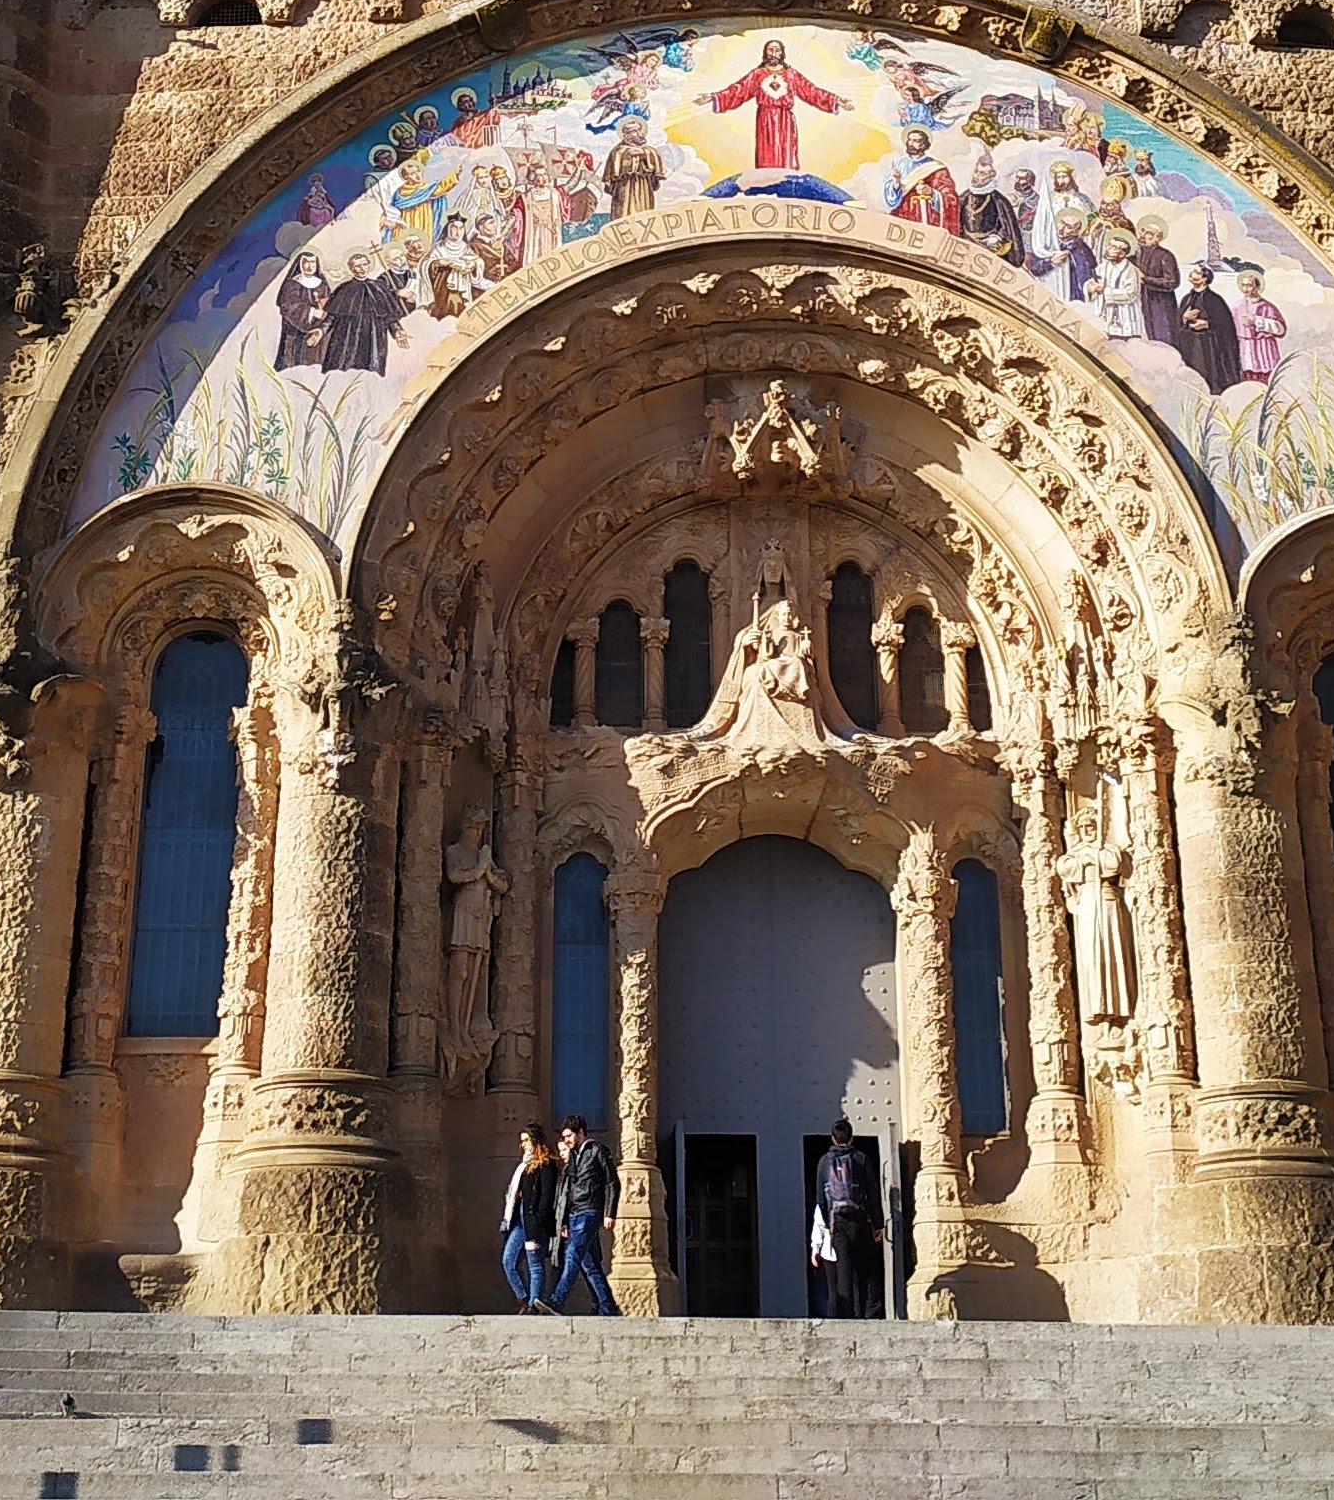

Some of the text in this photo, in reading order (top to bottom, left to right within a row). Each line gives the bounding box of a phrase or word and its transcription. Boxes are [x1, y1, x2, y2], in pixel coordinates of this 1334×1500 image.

[468, 203, 1082, 342] TEMPLO EXPIATORIO DE ESPAÑA
